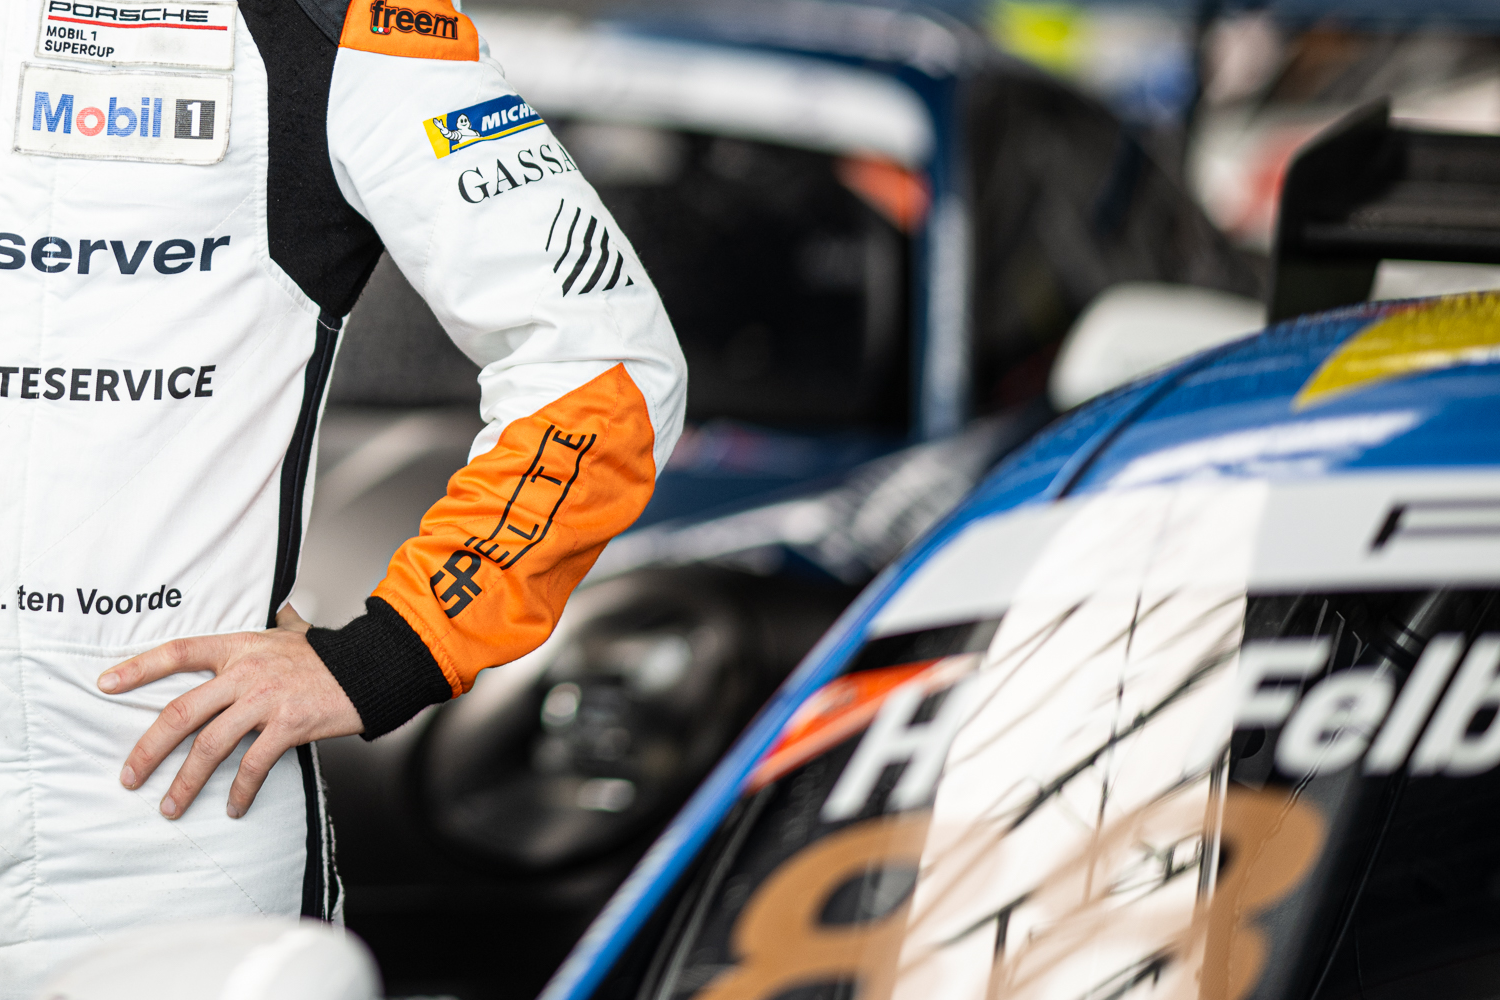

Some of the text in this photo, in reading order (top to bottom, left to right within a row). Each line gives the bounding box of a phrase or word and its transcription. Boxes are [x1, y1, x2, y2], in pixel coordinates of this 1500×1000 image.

[49, 0, 209, 23] PORSCHE
[46, 25, 98, 42] MOBIL 1
[44, 39, 115, 58] SUPERCUP
[32, 91, 163, 139] Mobil
[16, 584, 65, 613] ten
[76, 583, 183, 616] Voorde
